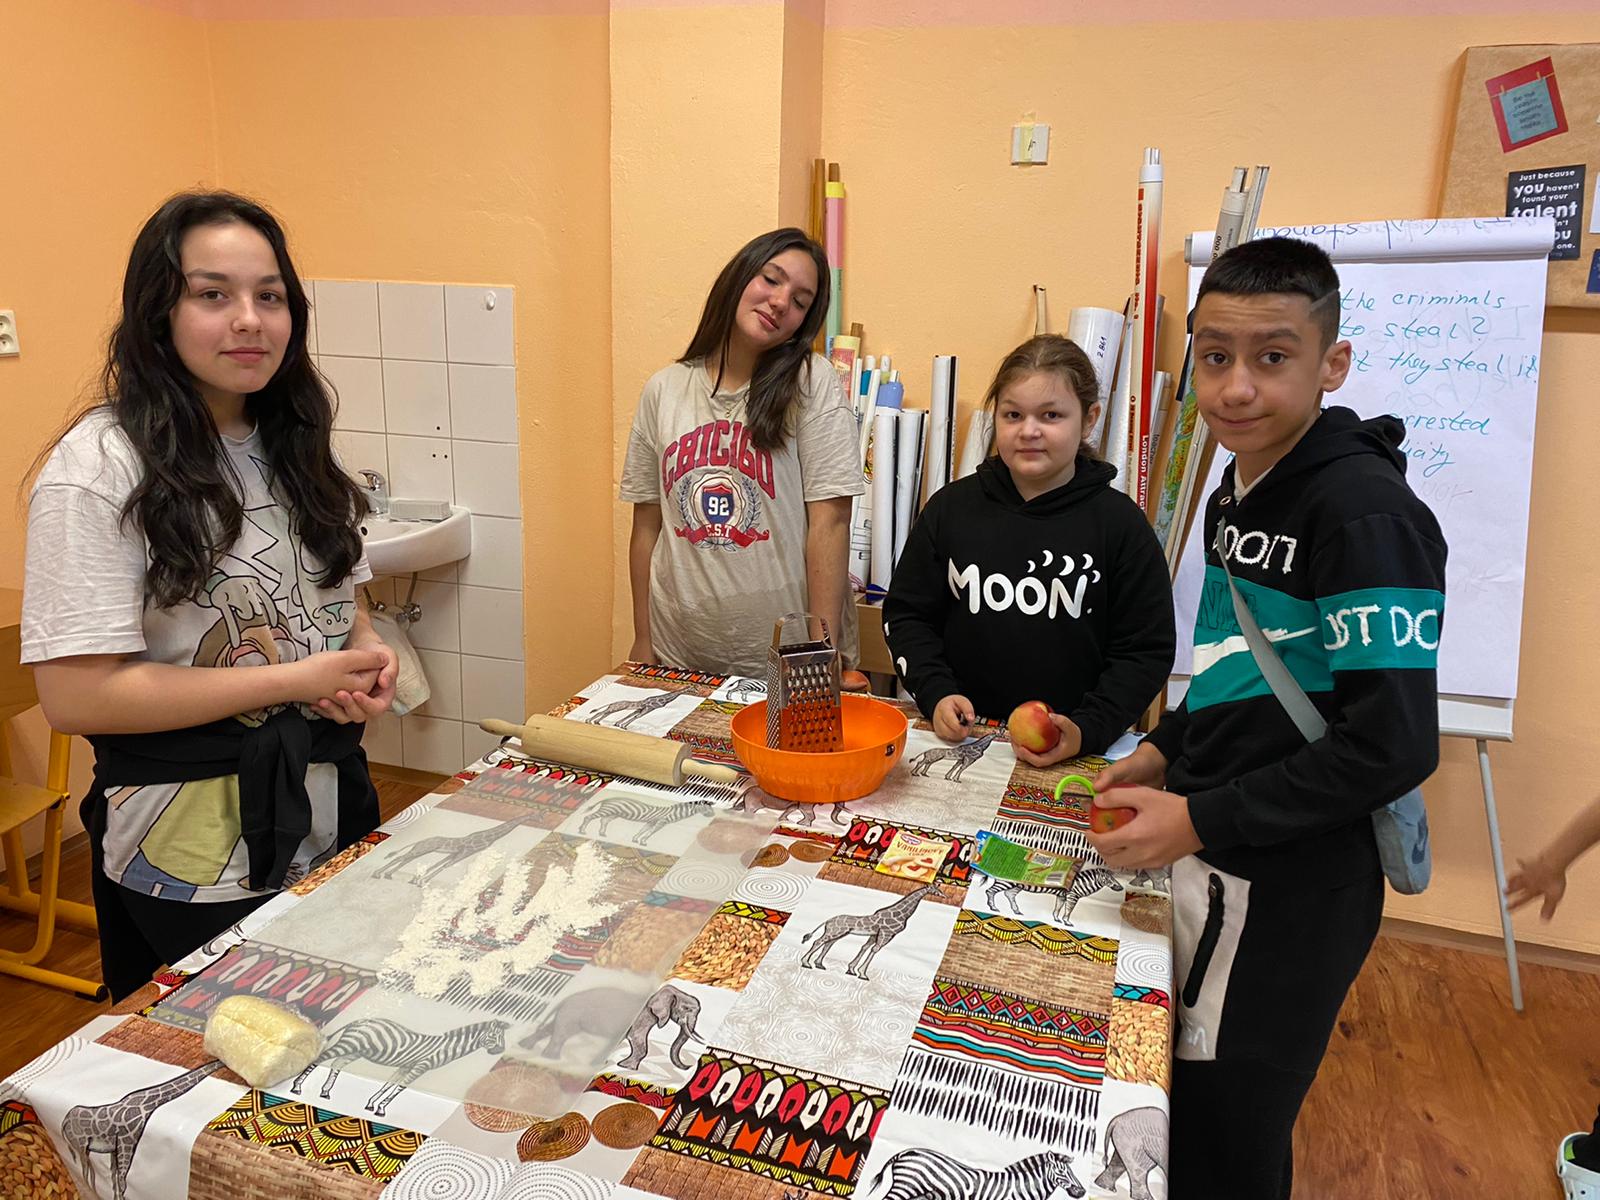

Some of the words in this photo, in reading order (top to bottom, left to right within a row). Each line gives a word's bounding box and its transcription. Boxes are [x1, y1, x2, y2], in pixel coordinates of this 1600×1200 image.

[1519, 173, 1536, 181] Just
[1538, 170, 1575, 180] because
[1513, 183, 1545, 199] you
[1546, 182, 1580, 192] haven't
[1522, 195, 1546, 203] found
[1548, 193, 1569, 202] your
[1511, 201, 1578, 218] talent
[1553, 230, 1572, 240] ou
[1341, 288, 1376, 311] the
[1392, 289, 1506, 309] criminals
[1339, 316, 1366, 337] to
[1389, 350, 1431, 385] they
[1434, 350, 1504, 374] steal
[1390, 410, 1491, 435] rrested
[1141, 435, 1149, 473] London
[708, 496, 730, 516] 92
